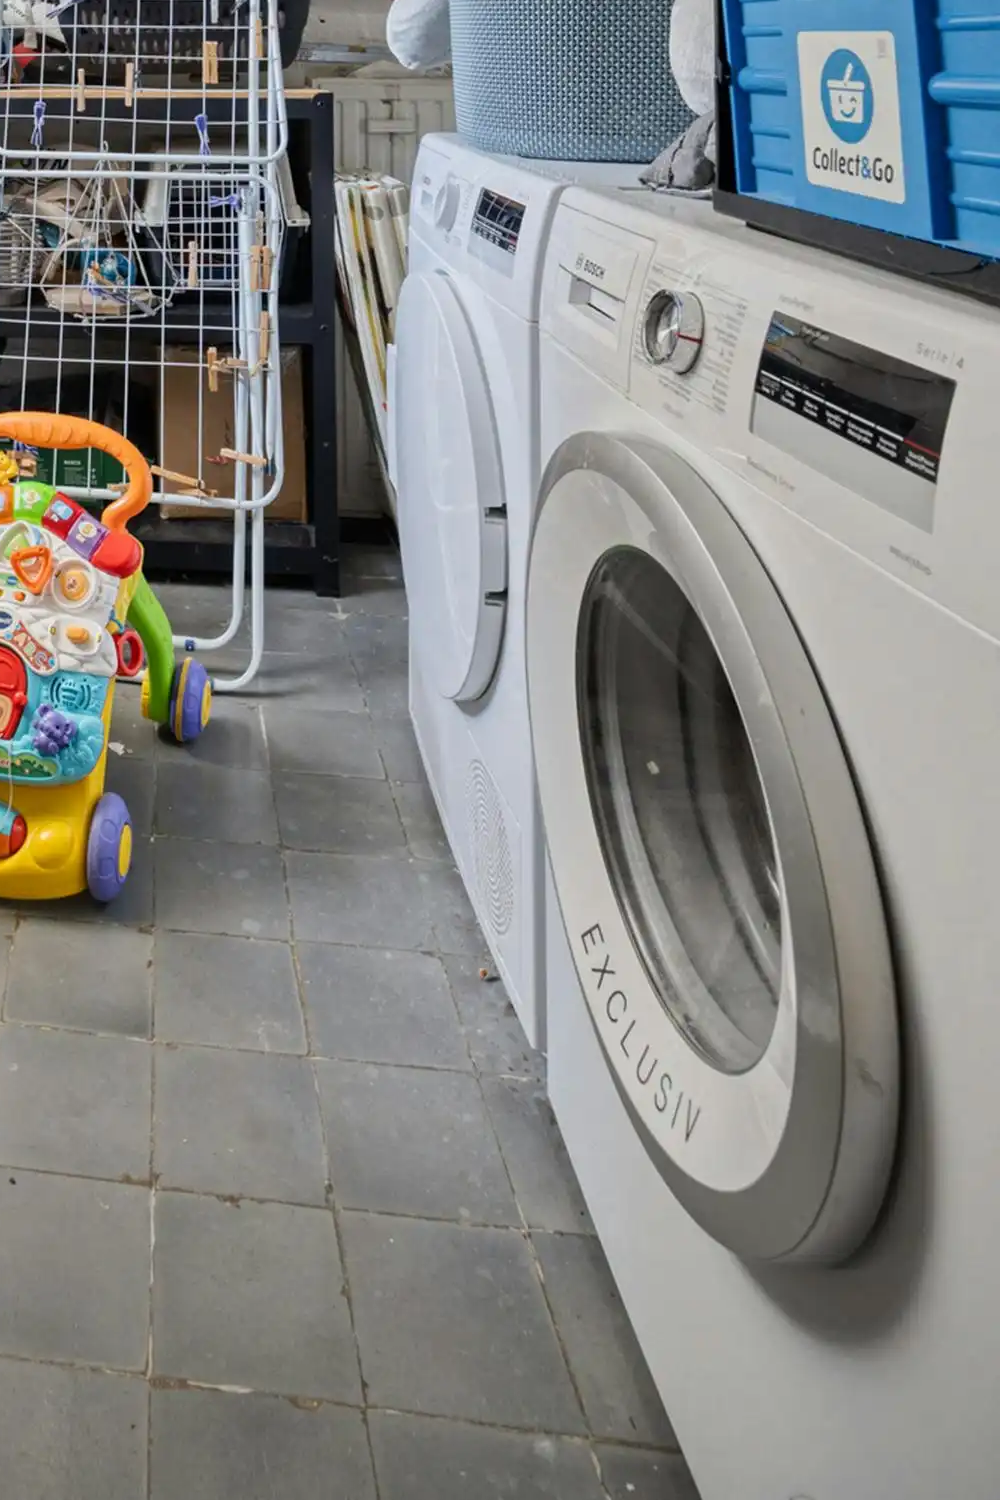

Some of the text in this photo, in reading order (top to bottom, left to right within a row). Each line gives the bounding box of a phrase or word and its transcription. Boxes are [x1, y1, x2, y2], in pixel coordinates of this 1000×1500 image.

[812, 146, 895, 184] Collect&Go
[583, 258, 606, 280] BOSCH
[916, 342, 965, 370] Serie 4
[580, 923, 701, 1143] EXCLUSIV
